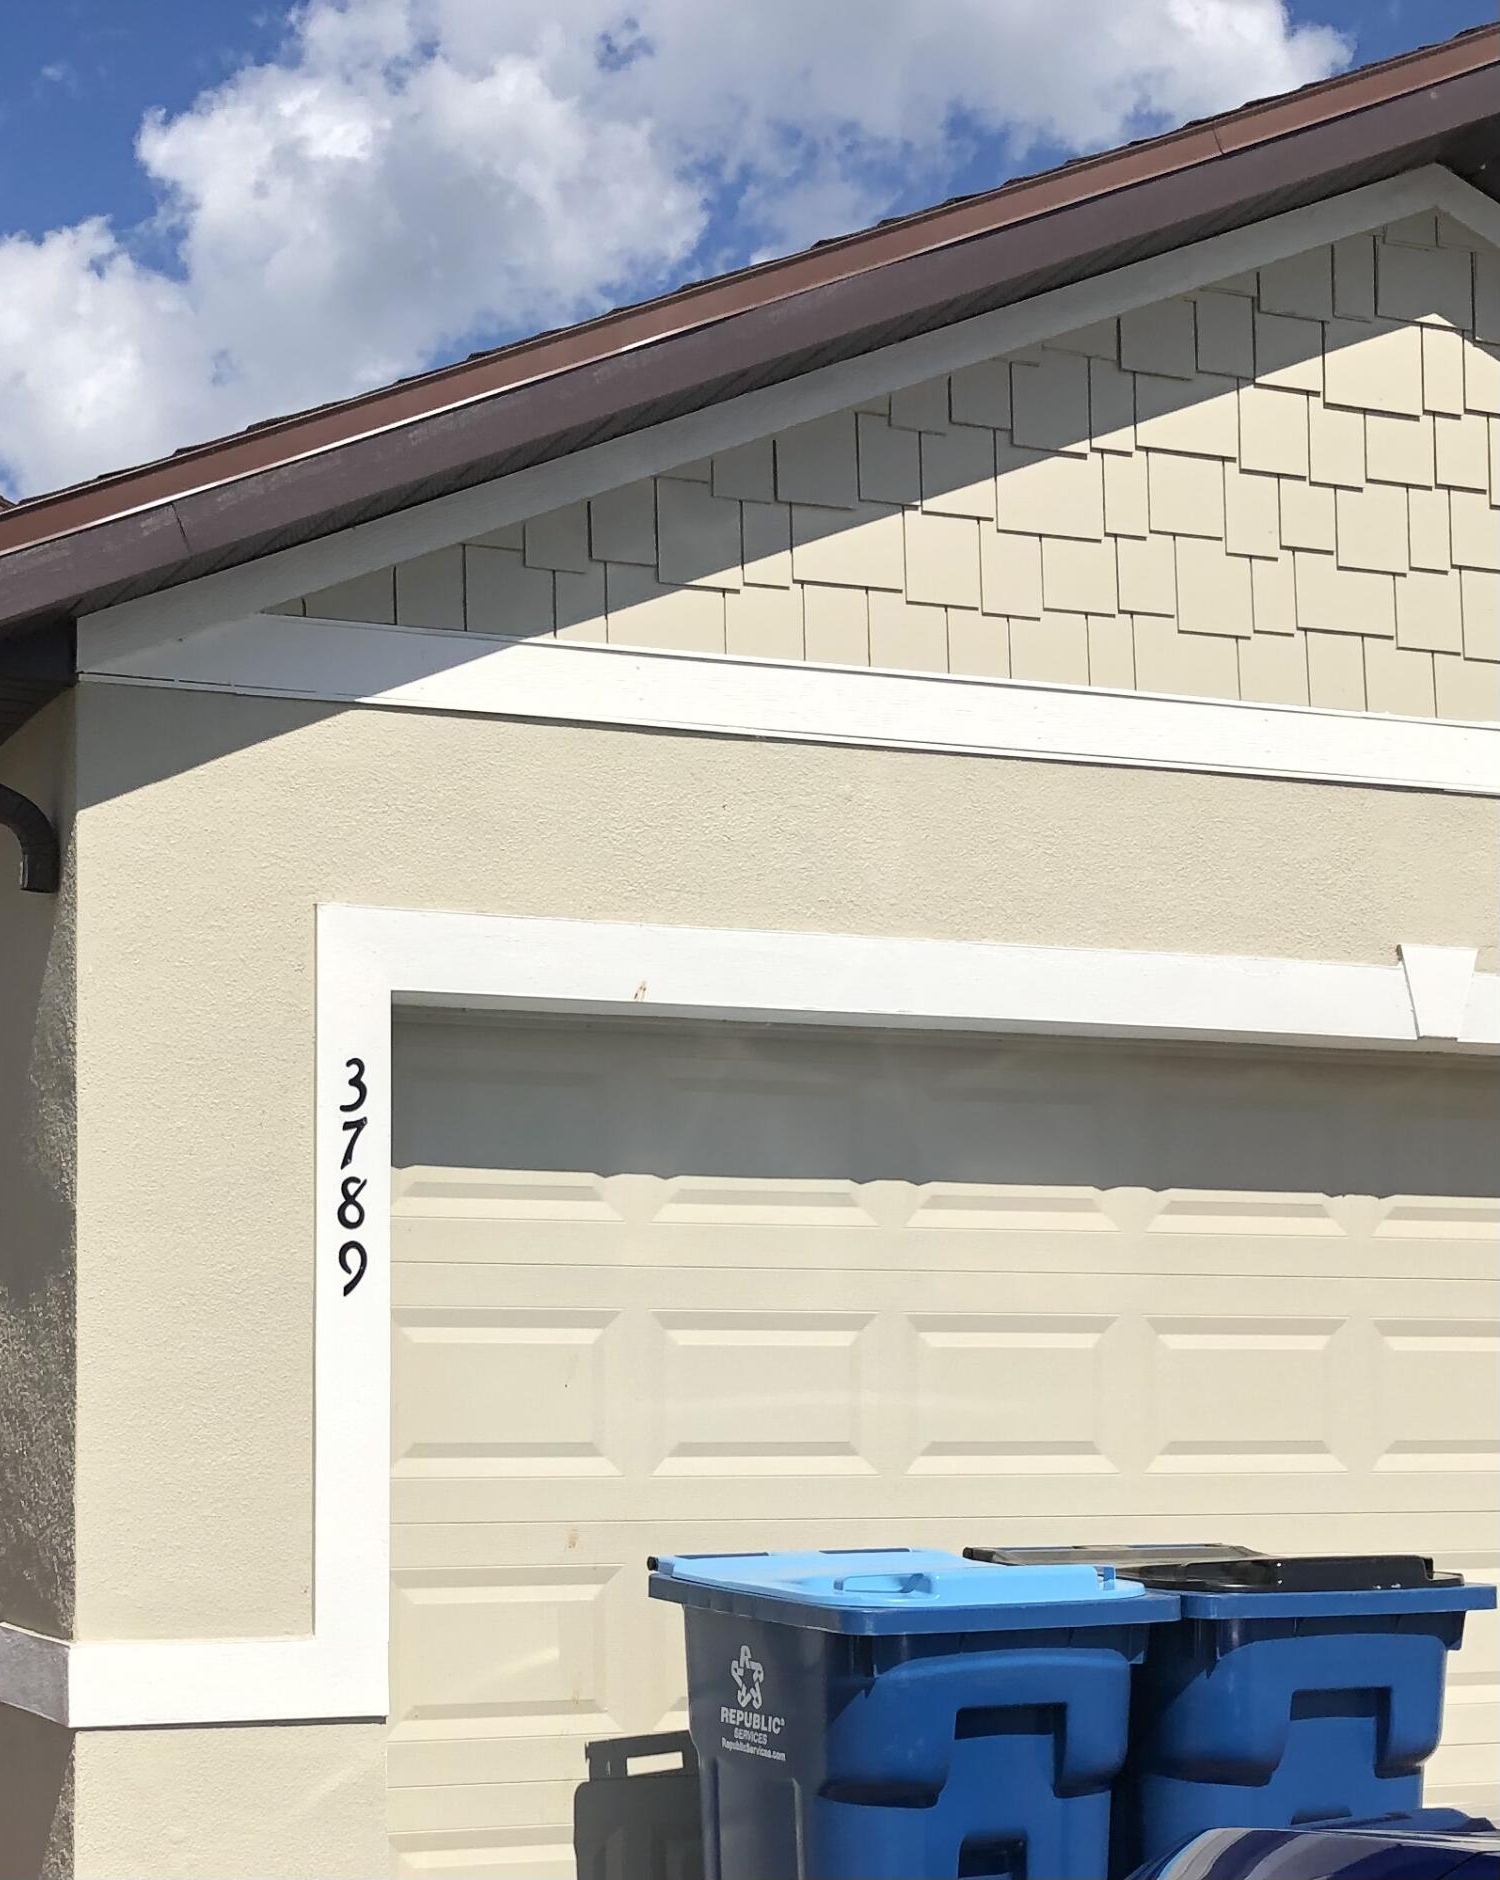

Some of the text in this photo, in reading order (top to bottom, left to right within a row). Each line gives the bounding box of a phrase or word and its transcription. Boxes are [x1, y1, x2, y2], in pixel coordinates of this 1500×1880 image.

[337, 1057, 368, 1297] 3789
[720, 1706, 782, 1735] REPUBLIC
[733, 1727, 768, 1746] SERVICES
